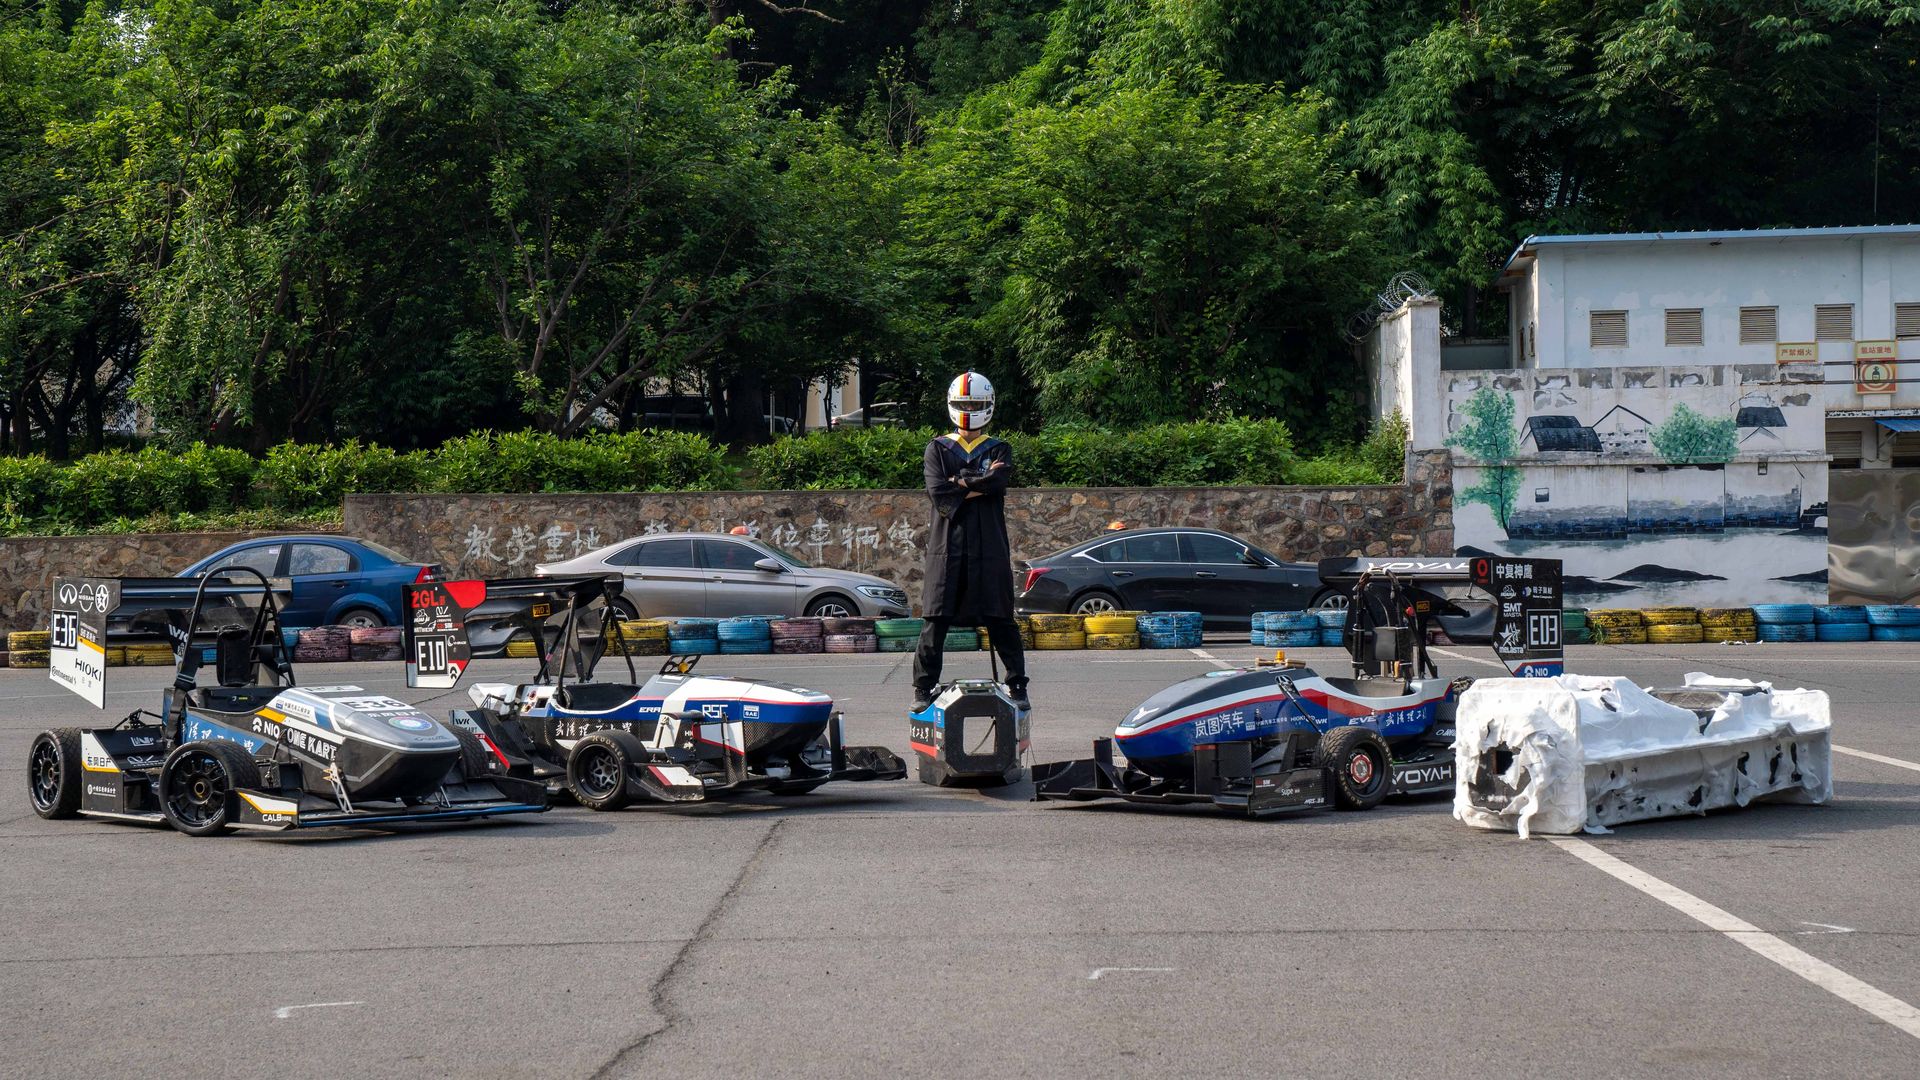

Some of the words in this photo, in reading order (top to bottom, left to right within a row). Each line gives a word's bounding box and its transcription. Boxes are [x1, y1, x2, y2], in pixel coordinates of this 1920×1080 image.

[1496, 564, 1532, 579] 中复神鹰
[78, 594, 95, 602] NISSAN
[1503, 602, 1522, 612] SMT
[53, 613, 77, 648] E36
[1530, 615, 1558, 645] E03
[418, 641, 445, 671] E10
[75, 658, 102, 682] HIOKI
[1535, 668, 1549, 677] NIO
[263, 722, 281, 740] NIO
[1195, 710, 1244, 739] 岚图汽车
[262, 813, 282, 822] CALB
